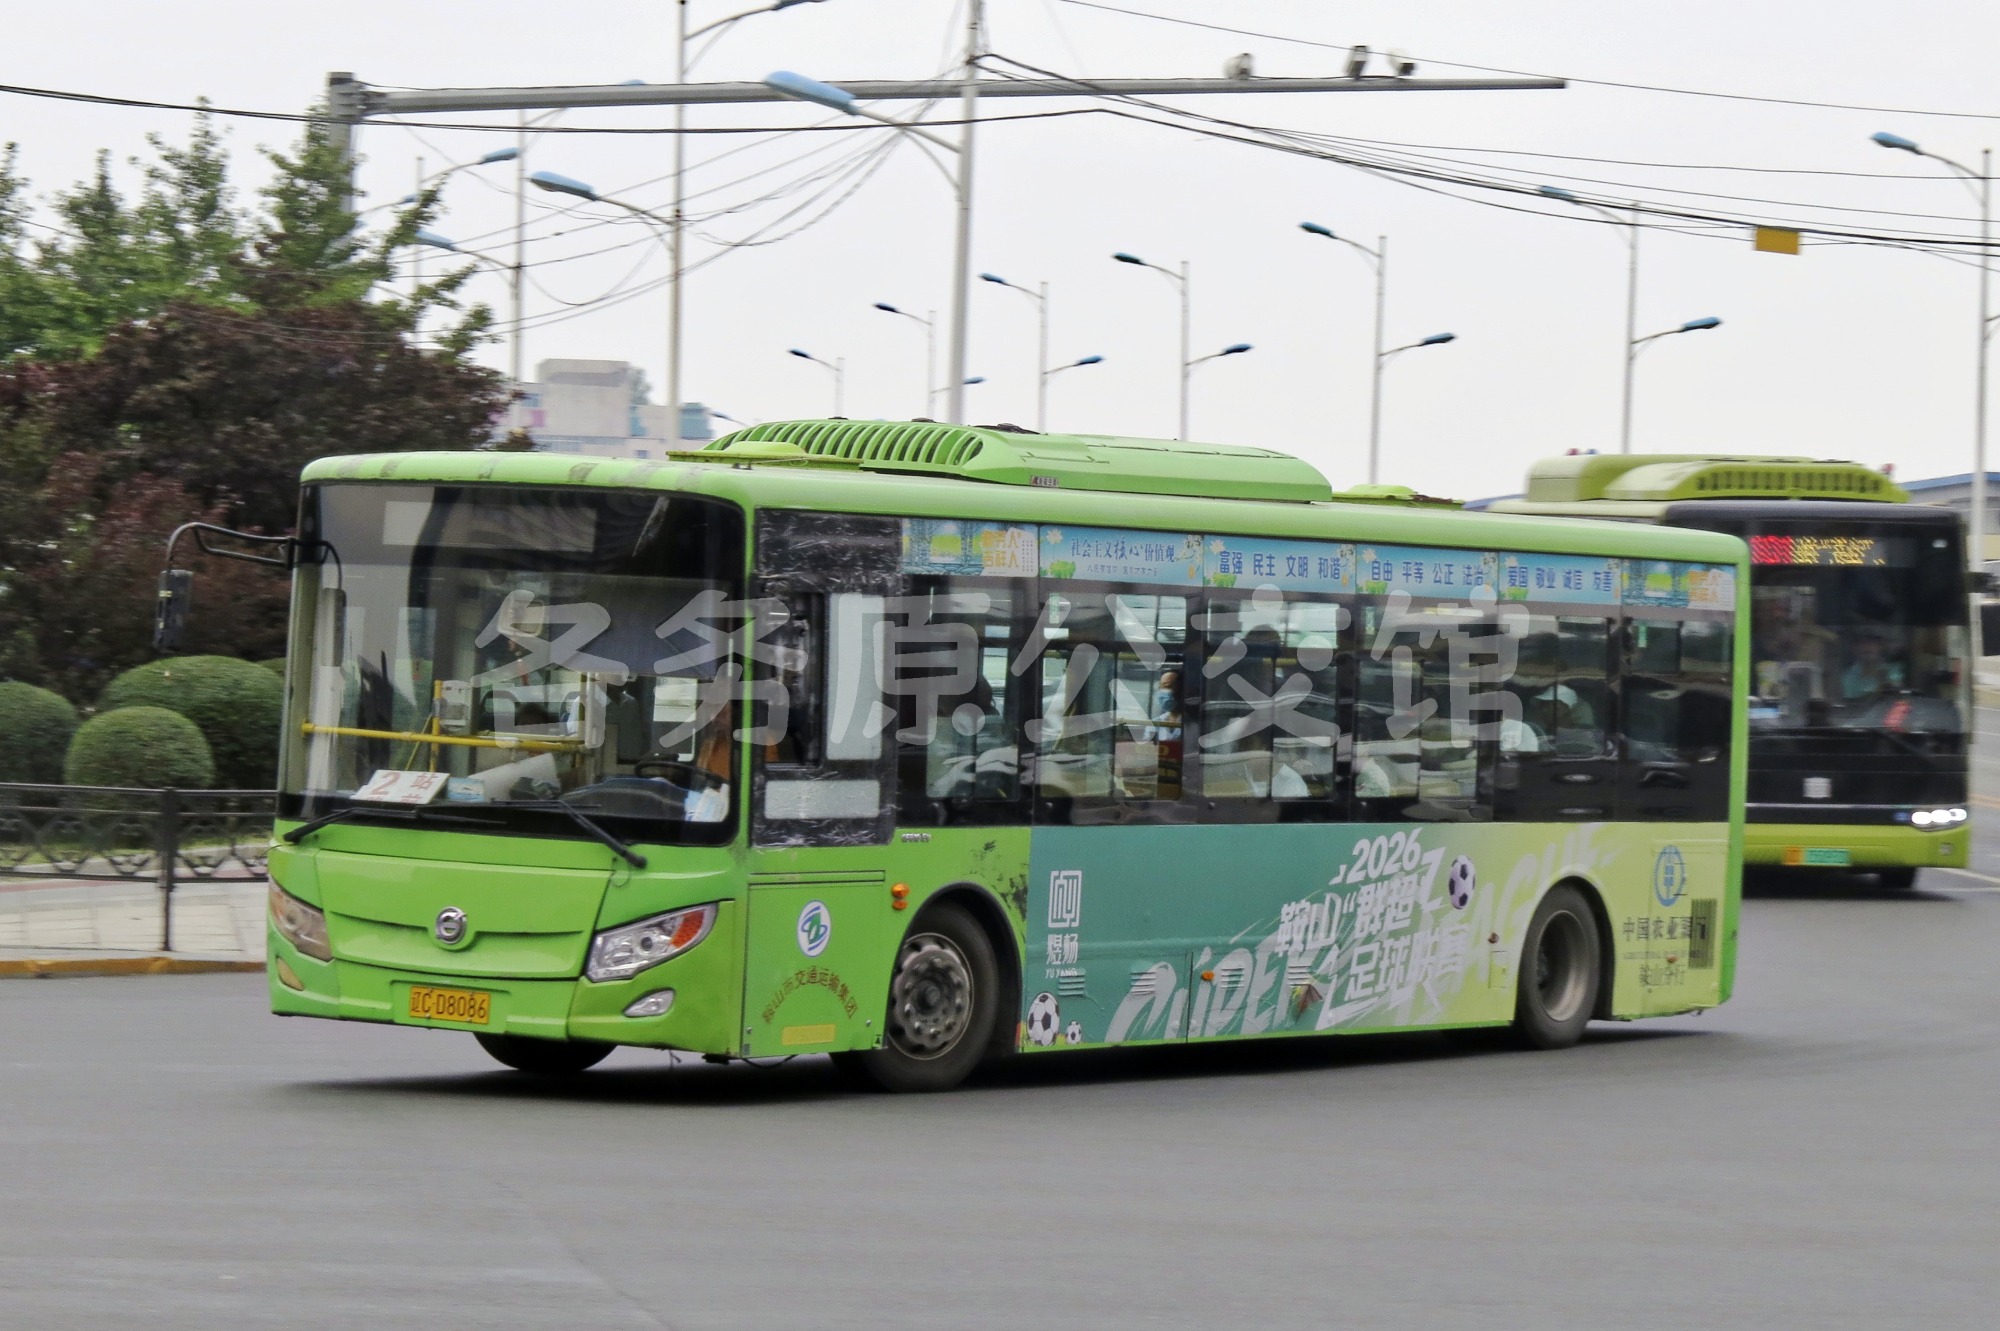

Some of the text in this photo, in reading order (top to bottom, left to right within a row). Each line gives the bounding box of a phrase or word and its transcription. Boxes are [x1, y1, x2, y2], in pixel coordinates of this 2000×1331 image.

[1071, 536, 1175, 562] 社会主义核心价值观
[1220, 551, 1341, 579] 富强 民主 文明 和谐
[1371, 559, 1484, 586] 自由 平等 公正 法治
[1507, 566, 1612, 592] 爱国 敬业 诚信 友善
[1346, 827, 1423, 884] 2026
